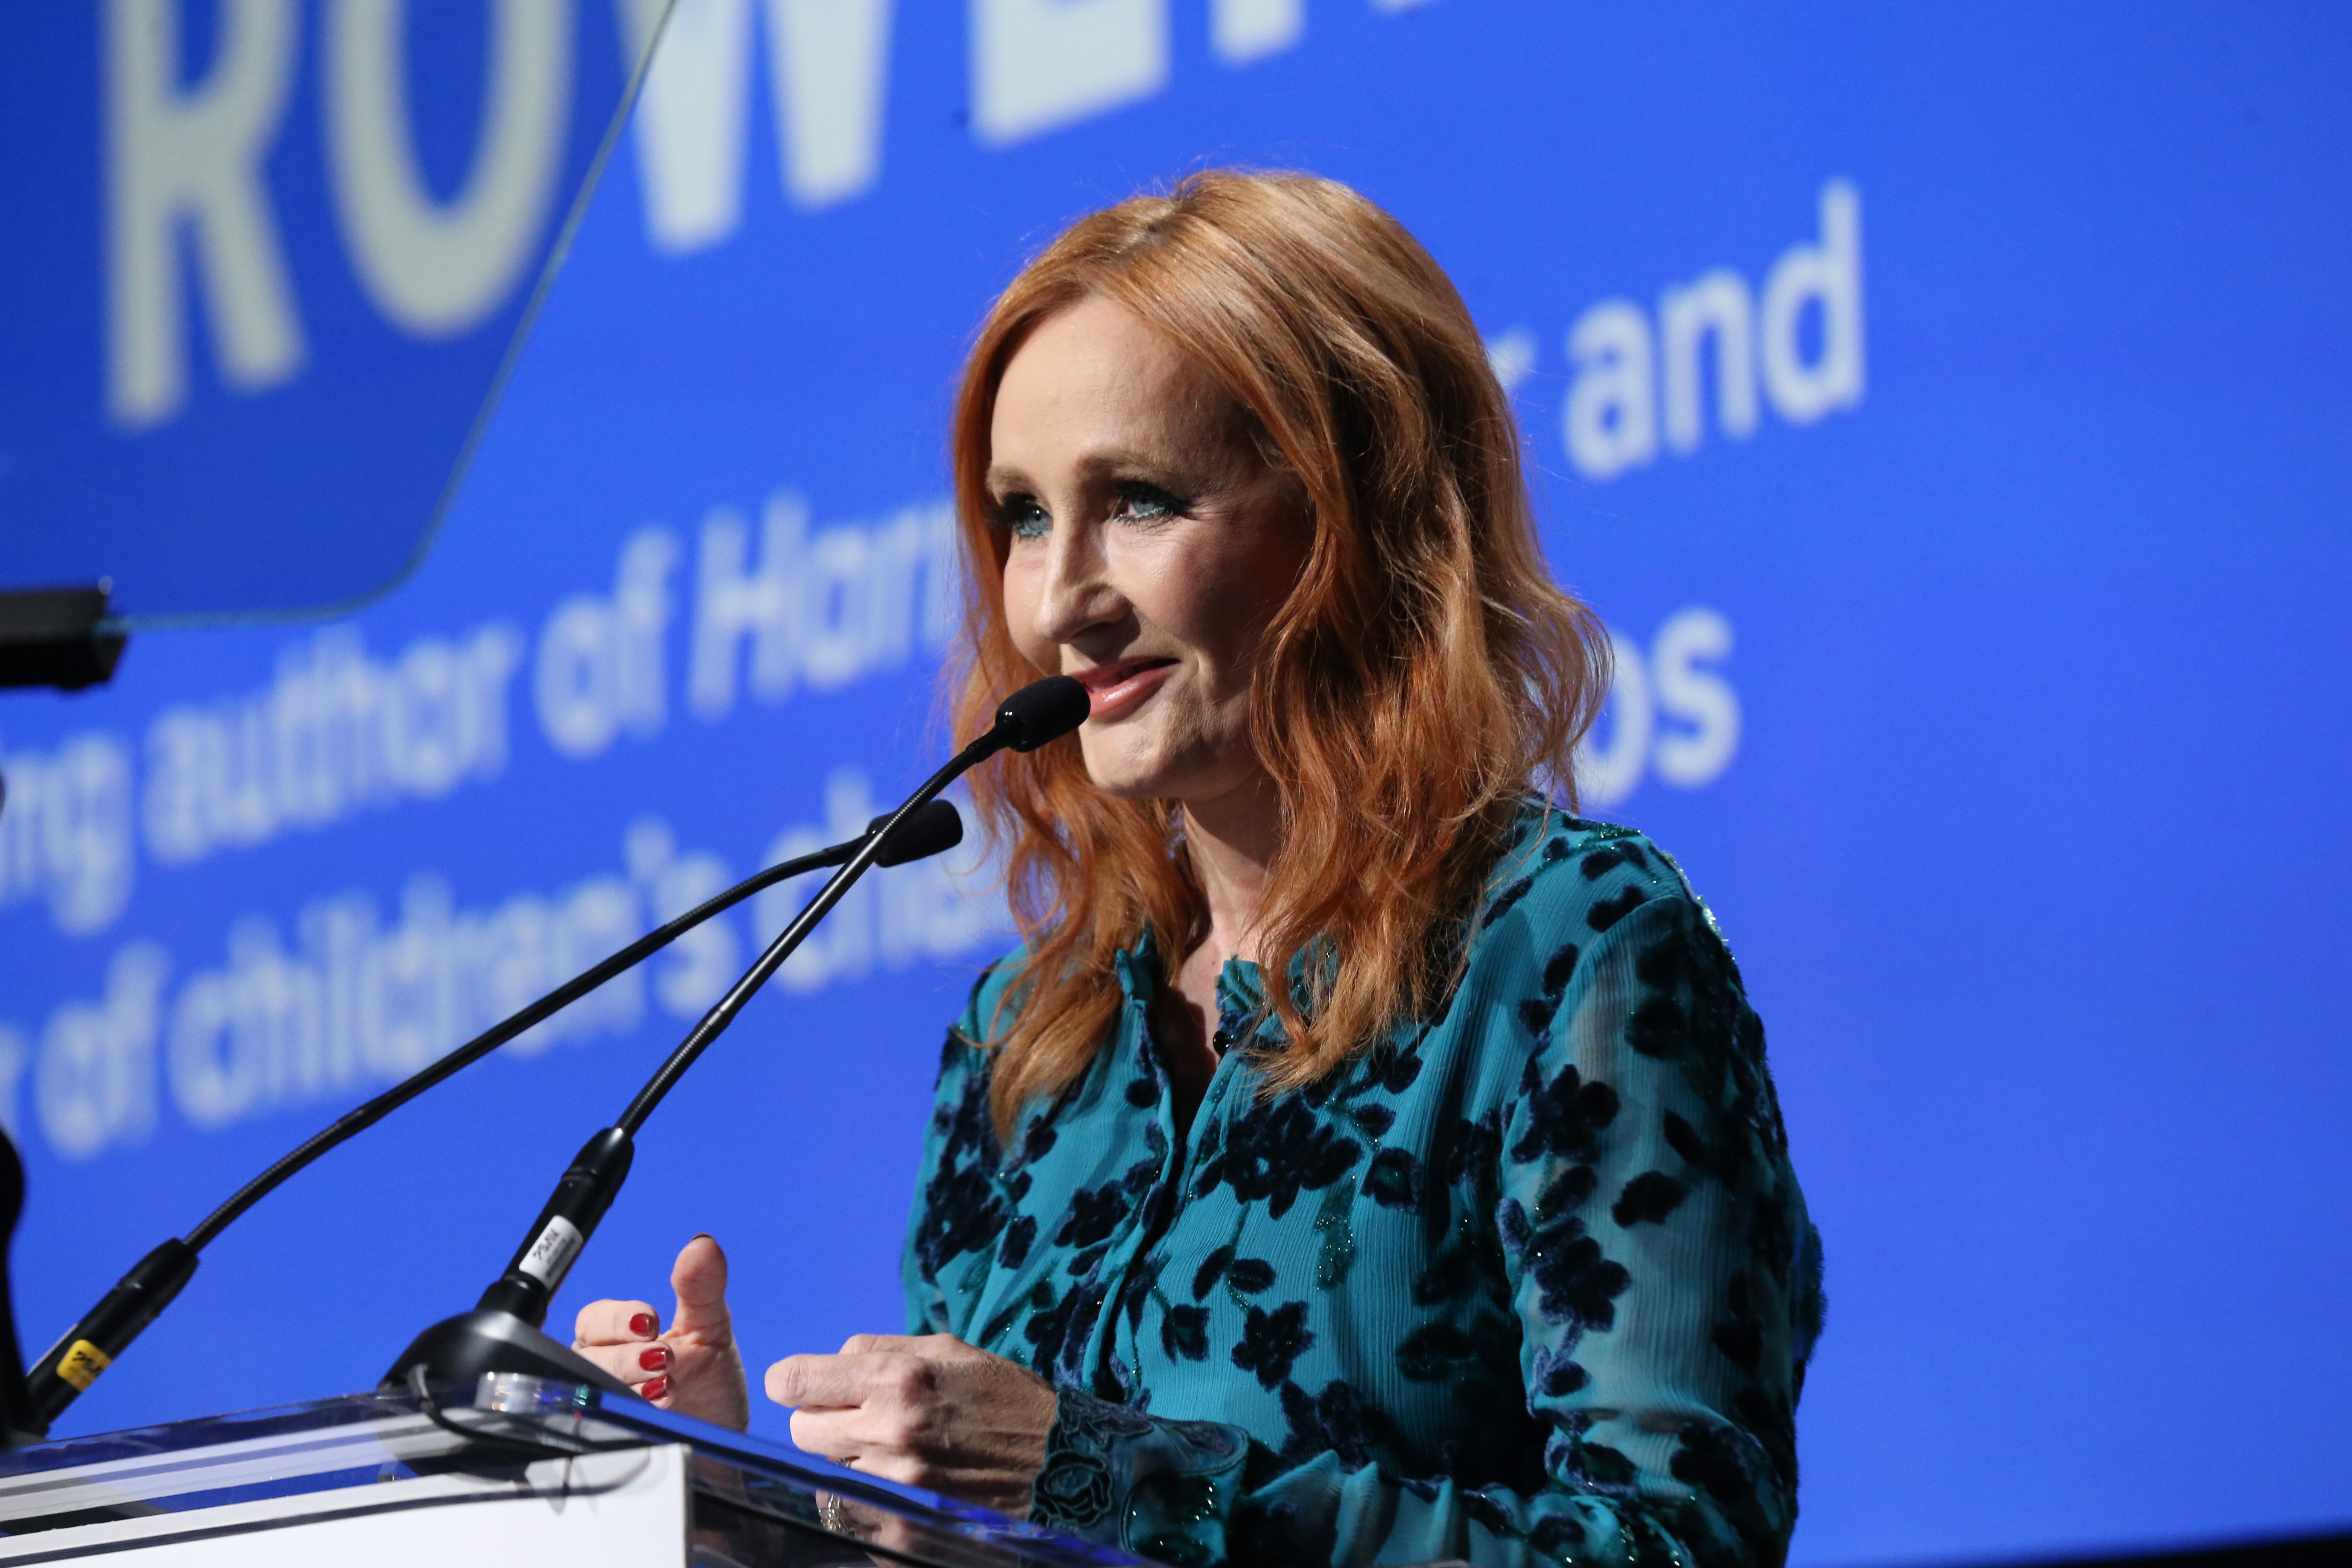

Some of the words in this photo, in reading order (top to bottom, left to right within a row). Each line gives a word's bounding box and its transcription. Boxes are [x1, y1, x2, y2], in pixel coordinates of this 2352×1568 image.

[145, 628, 517, 860] author
[537, 531, 675, 755] of
[1562, 181, 1866, 481] and
[41, 955, 162, 1155] of
[170, 828, 738, 1124] children's
